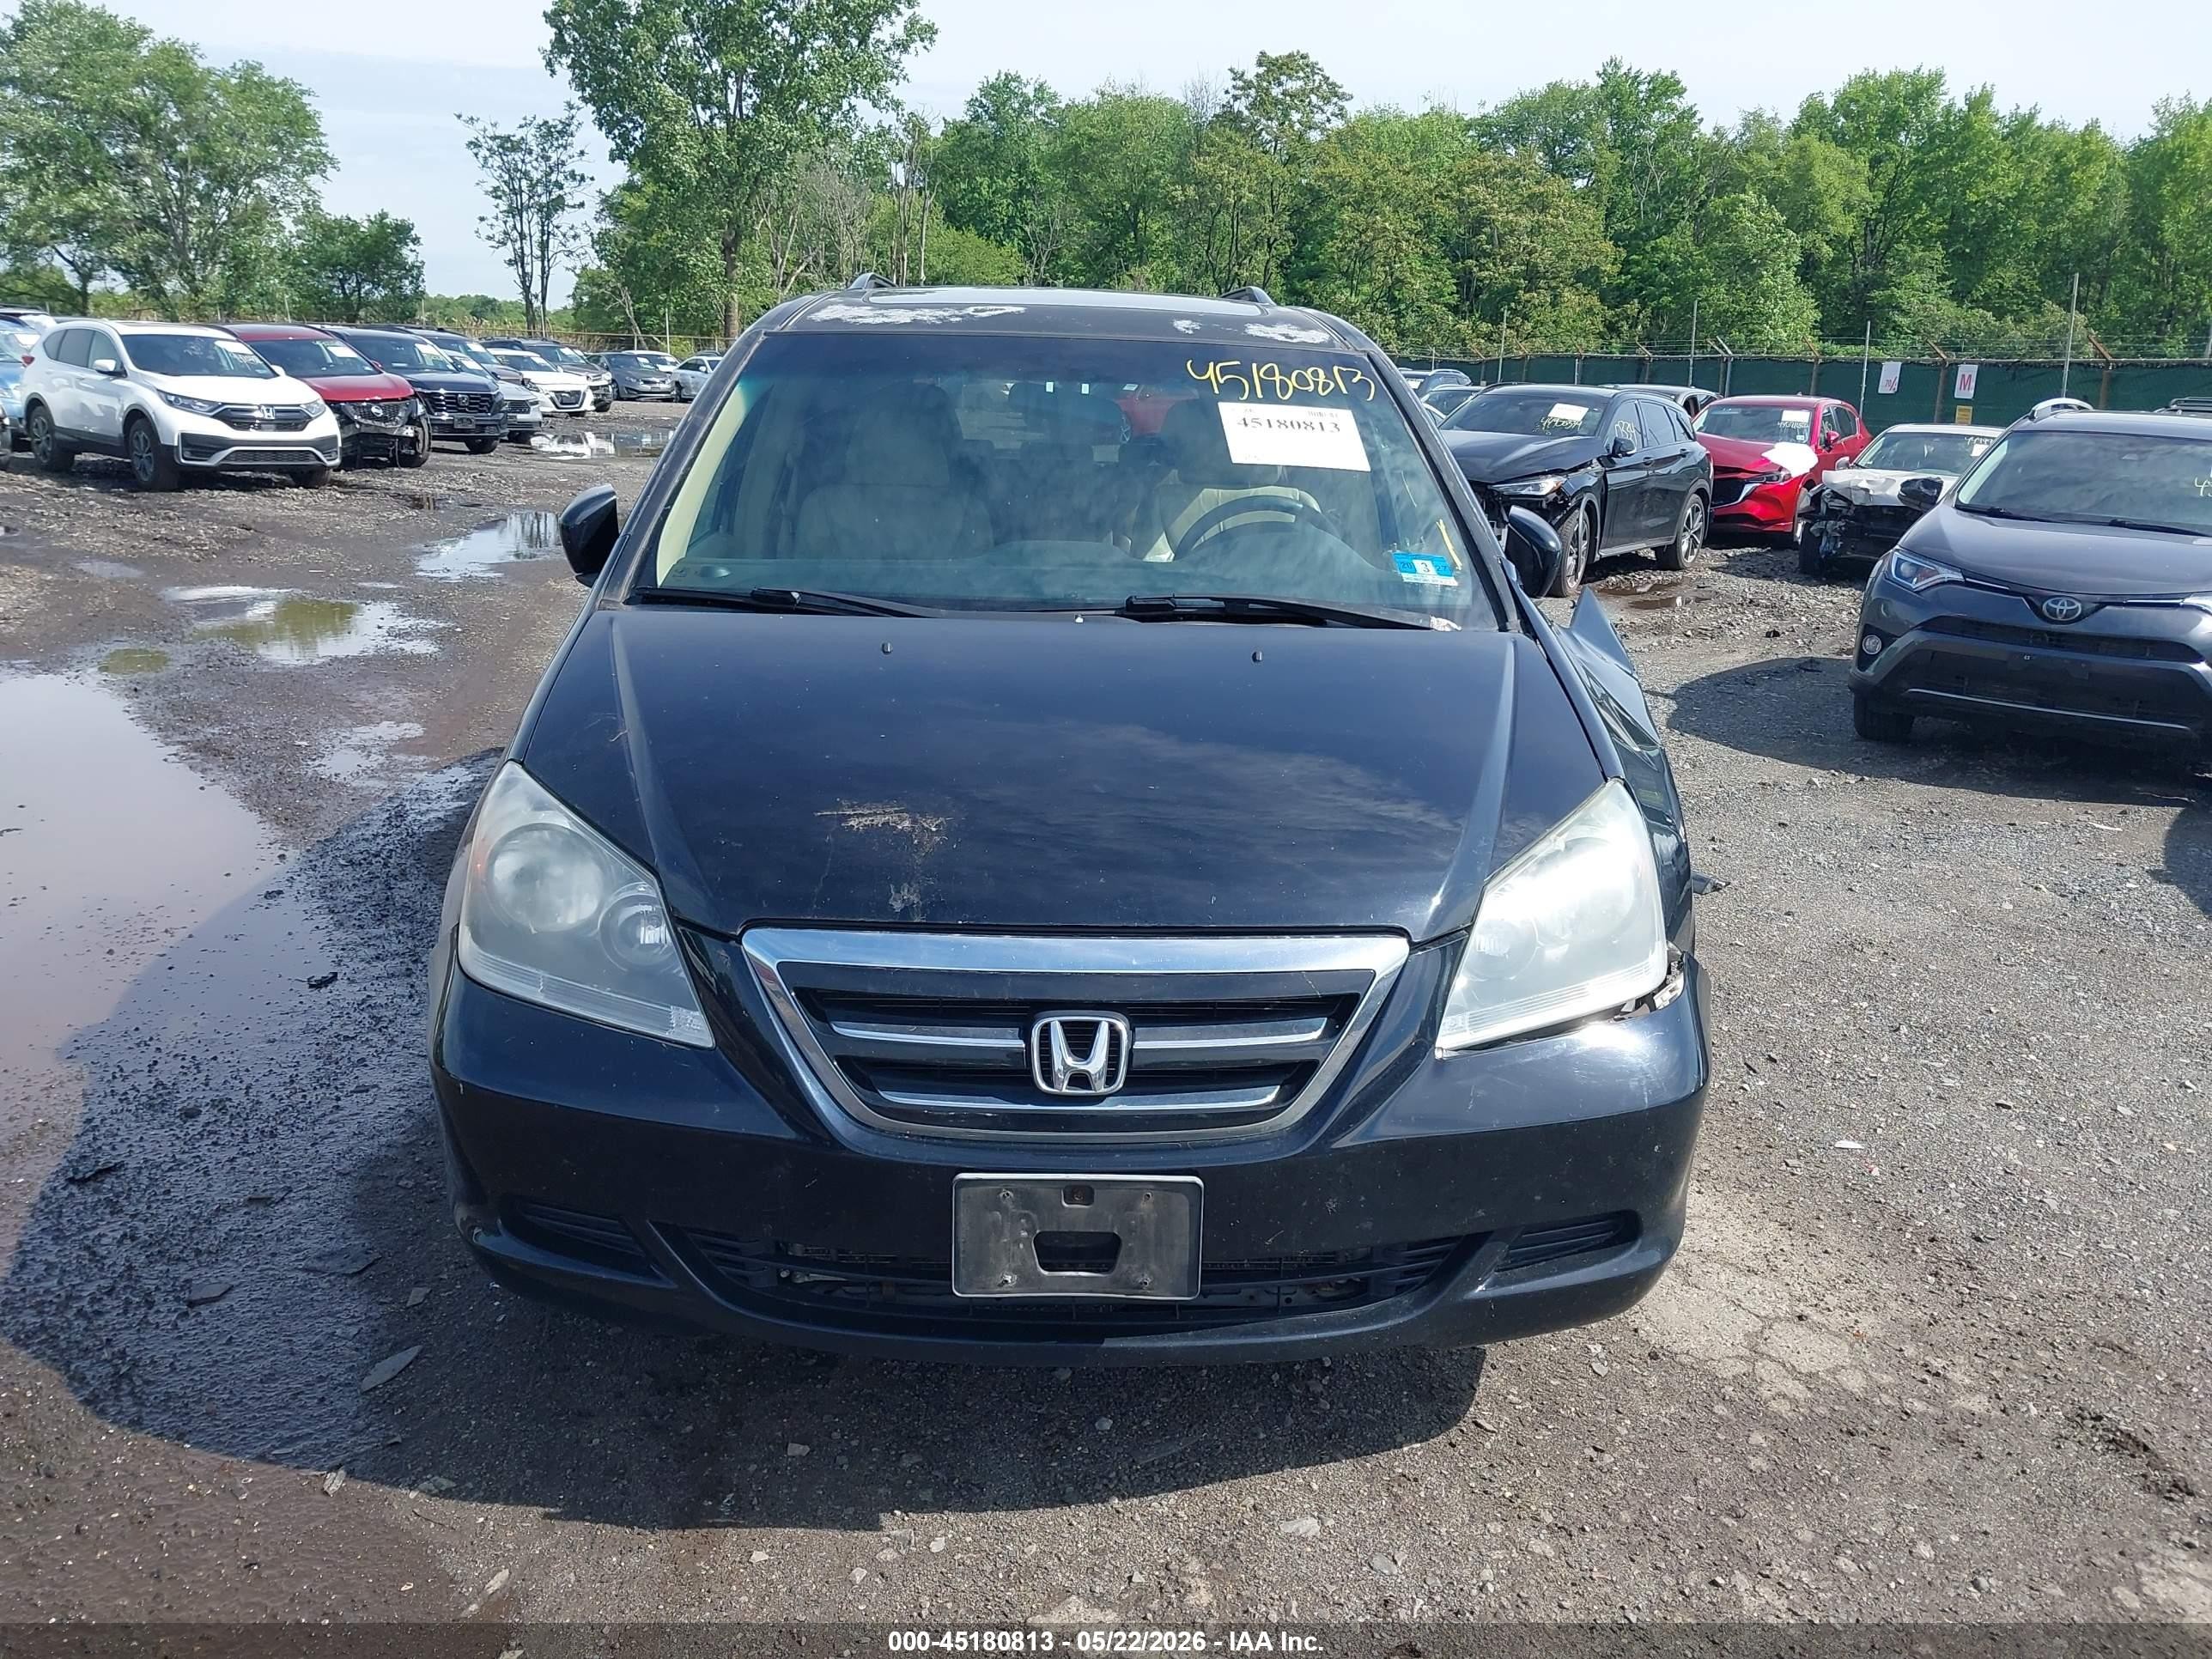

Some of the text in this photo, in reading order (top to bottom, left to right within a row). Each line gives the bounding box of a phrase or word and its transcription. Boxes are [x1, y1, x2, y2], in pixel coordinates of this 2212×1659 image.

[1186, 359, 1375, 401] 45180813
[1959, 374, 1972, 392] M
[1237, 416, 1341, 434] 45180813
[1421, 562, 1431, 573] 3
